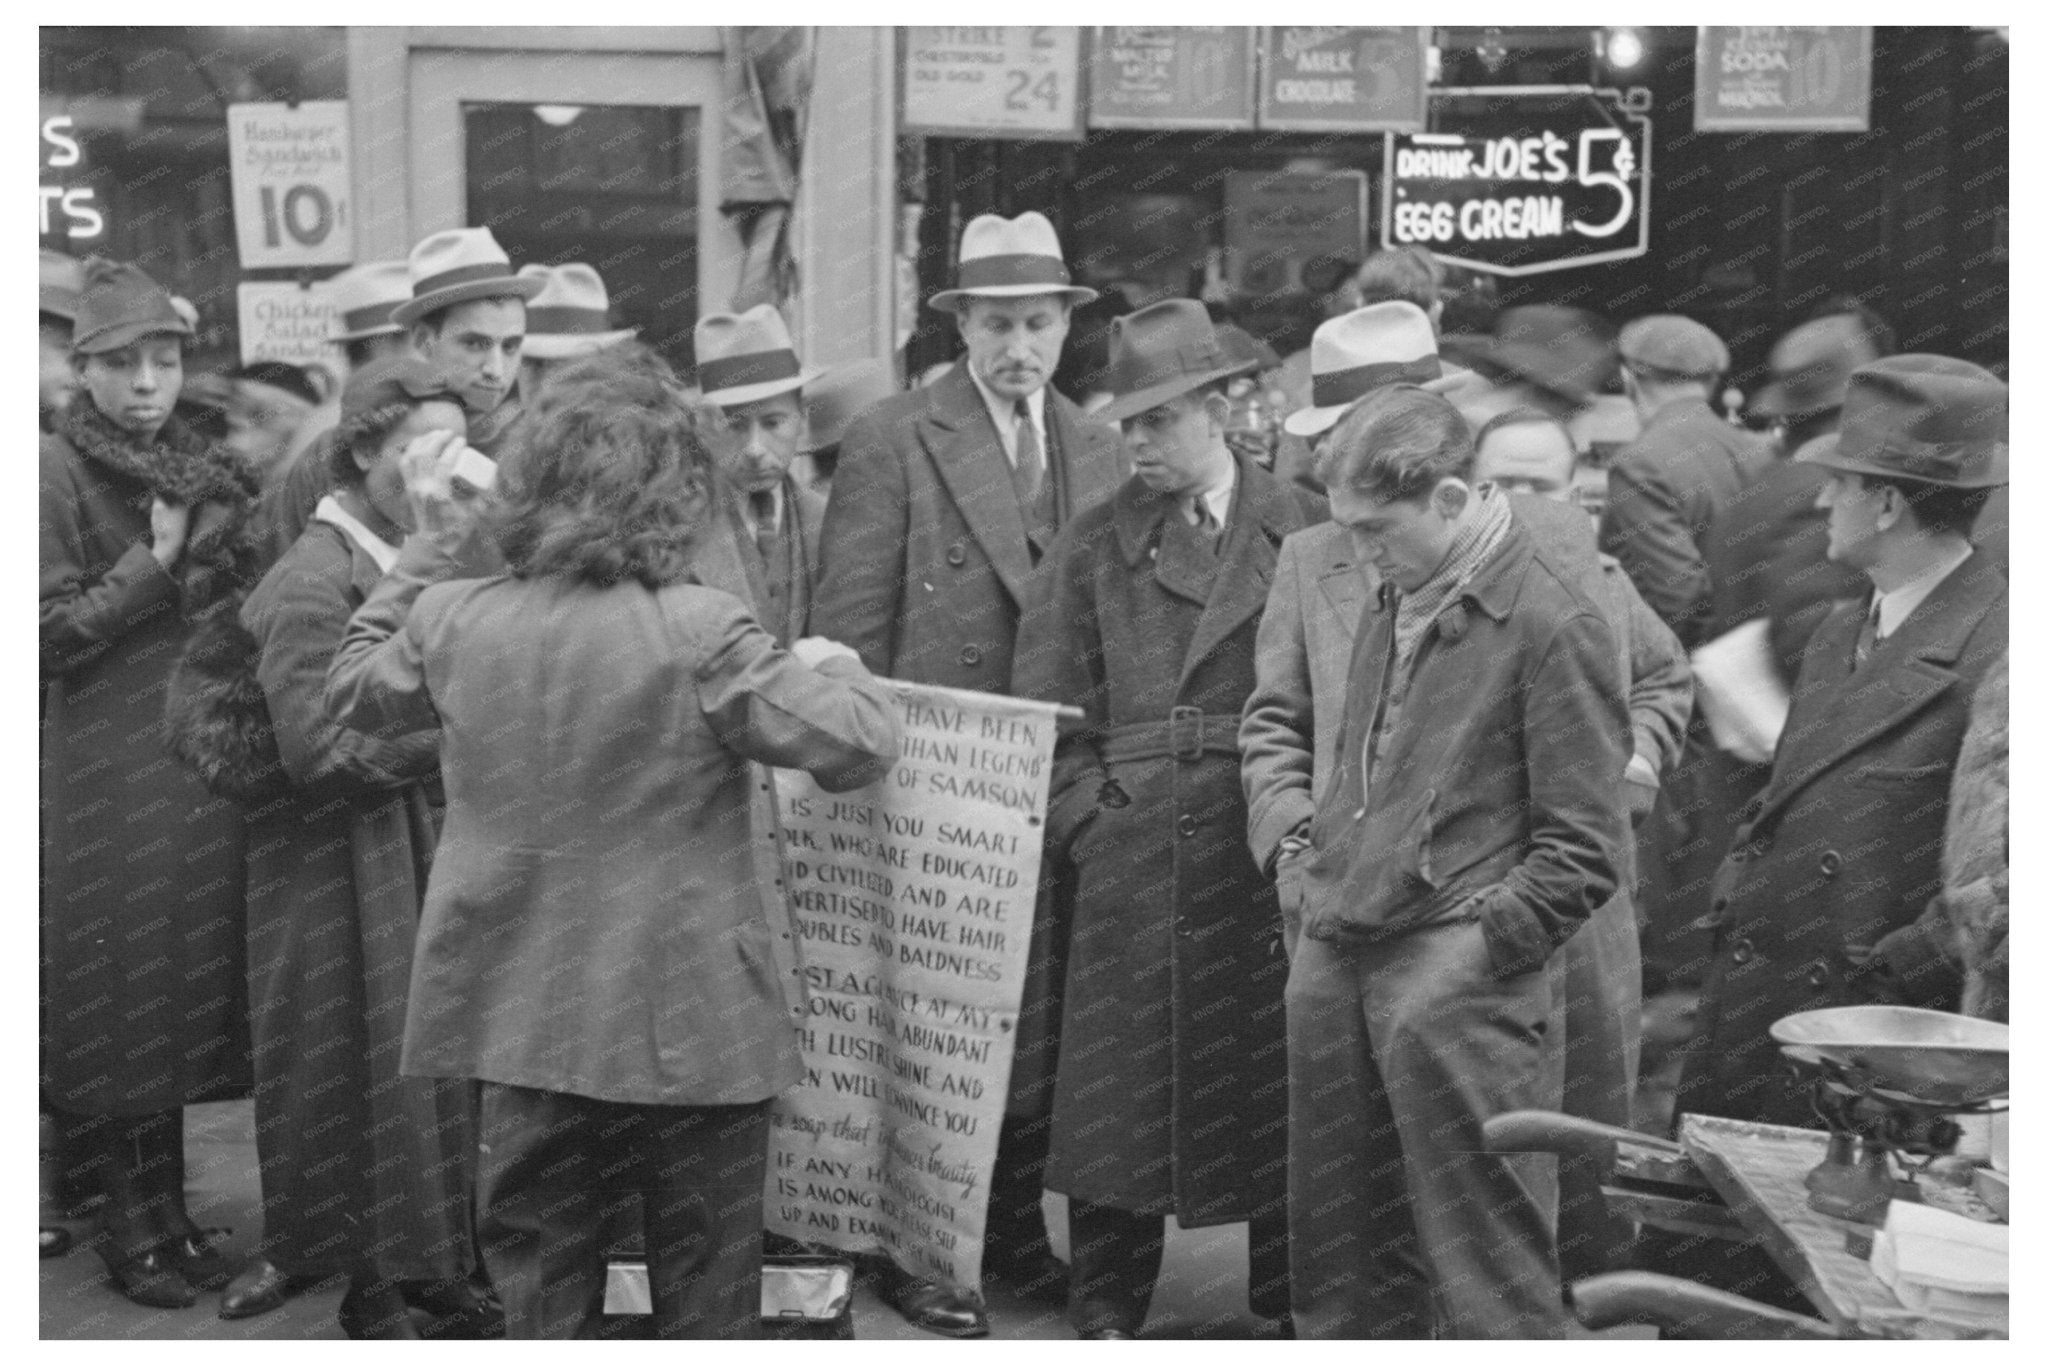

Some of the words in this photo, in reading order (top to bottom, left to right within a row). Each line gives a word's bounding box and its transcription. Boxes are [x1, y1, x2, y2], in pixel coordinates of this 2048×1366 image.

[1297, 50, 1353, 72] MILK
[1721, 51, 1789, 73] SODA
[1005, 69, 1059, 111] 24
[1396, 149, 1473, 179] DRINK
[1471, 130, 1570, 182] JOE'S
[1395, 202, 1454, 242] EGG
[1460, 195, 1563, 241] CREAM
[905, 704, 967, 734] HAVE
[981, 716, 1037, 747] BEEN
[903, 736, 958, 765] THAN
[897, 767, 922, 789] OF
[929, 772, 1037, 811] SAMSON
[791, 798, 812, 817] IS
[827, 802, 873, 826] JUST
[884, 813, 924, 837] YOU
[938, 823, 1021, 855] SMART
[831, 833, 871, 856] WHO
[876, 843, 910, 869] ARE
[922, 852, 1019, 889] EDUCATED
[901, 884, 947, 909] AND
[956, 895, 1011, 923] ARE
[902, 914, 950, 942] HAVE
[959, 926, 1007, 953] HAIR
[900, 946, 1002, 981] BALDNESS
[926, 998, 949, 1018] AT
[955, 1005, 993, 1030] MY
[902, 1024, 992, 1065] ABUNDANT
[893, 1055, 932, 1088] SHINE
[941, 1073, 984, 1100] AND
[832, 1071, 879, 1099] WILL
[945, 1111, 978, 1136] YOU
[833, 1112, 871, 1147] that
[777, 1151, 796, 1168] IF
[805, 1158, 852, 1179] ANY
[778, 1178, 798, 1197] IS
[805, 1183, 872, 1208] AMONG
[935, 1229, 958, 1250] STEP
[781, 1206, 802, 1222] UP
[808, 1212, 840, 1231] AND
